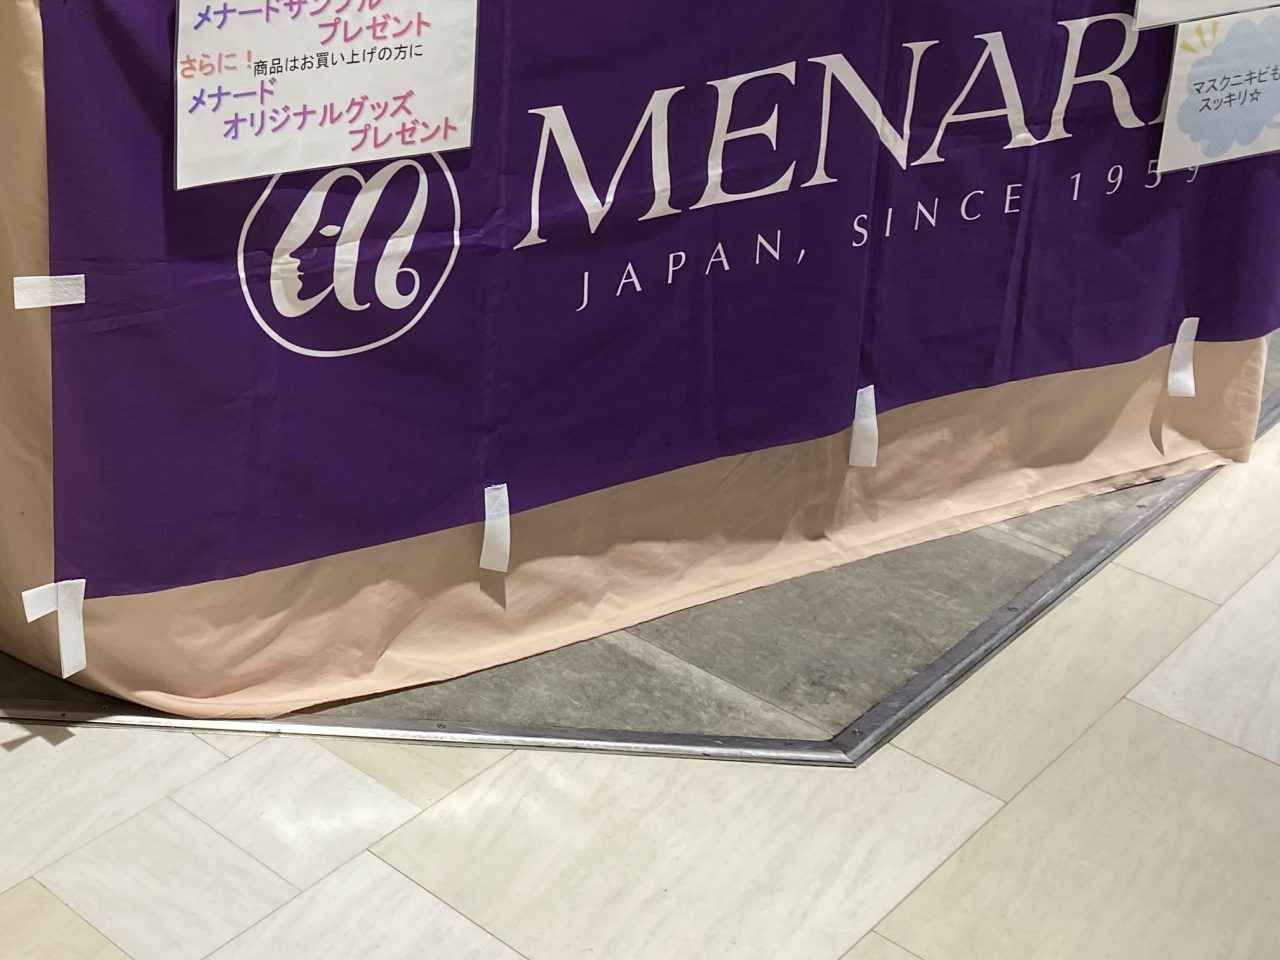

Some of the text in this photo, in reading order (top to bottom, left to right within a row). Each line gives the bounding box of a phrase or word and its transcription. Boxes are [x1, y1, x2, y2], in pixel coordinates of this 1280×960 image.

[318, 11, 432, 47] プレゼント
[253, 42, 424, 77] 商品はお買い上げの方に
[187, 77, 278, 115] メナード
[222, 89, 415, 141] オリジナルグッズ
[347, 116, 459, 153] プレゼント
[512, 10, 1166, 252] MENAR
[852, 180, 1024, 248] SINCE
